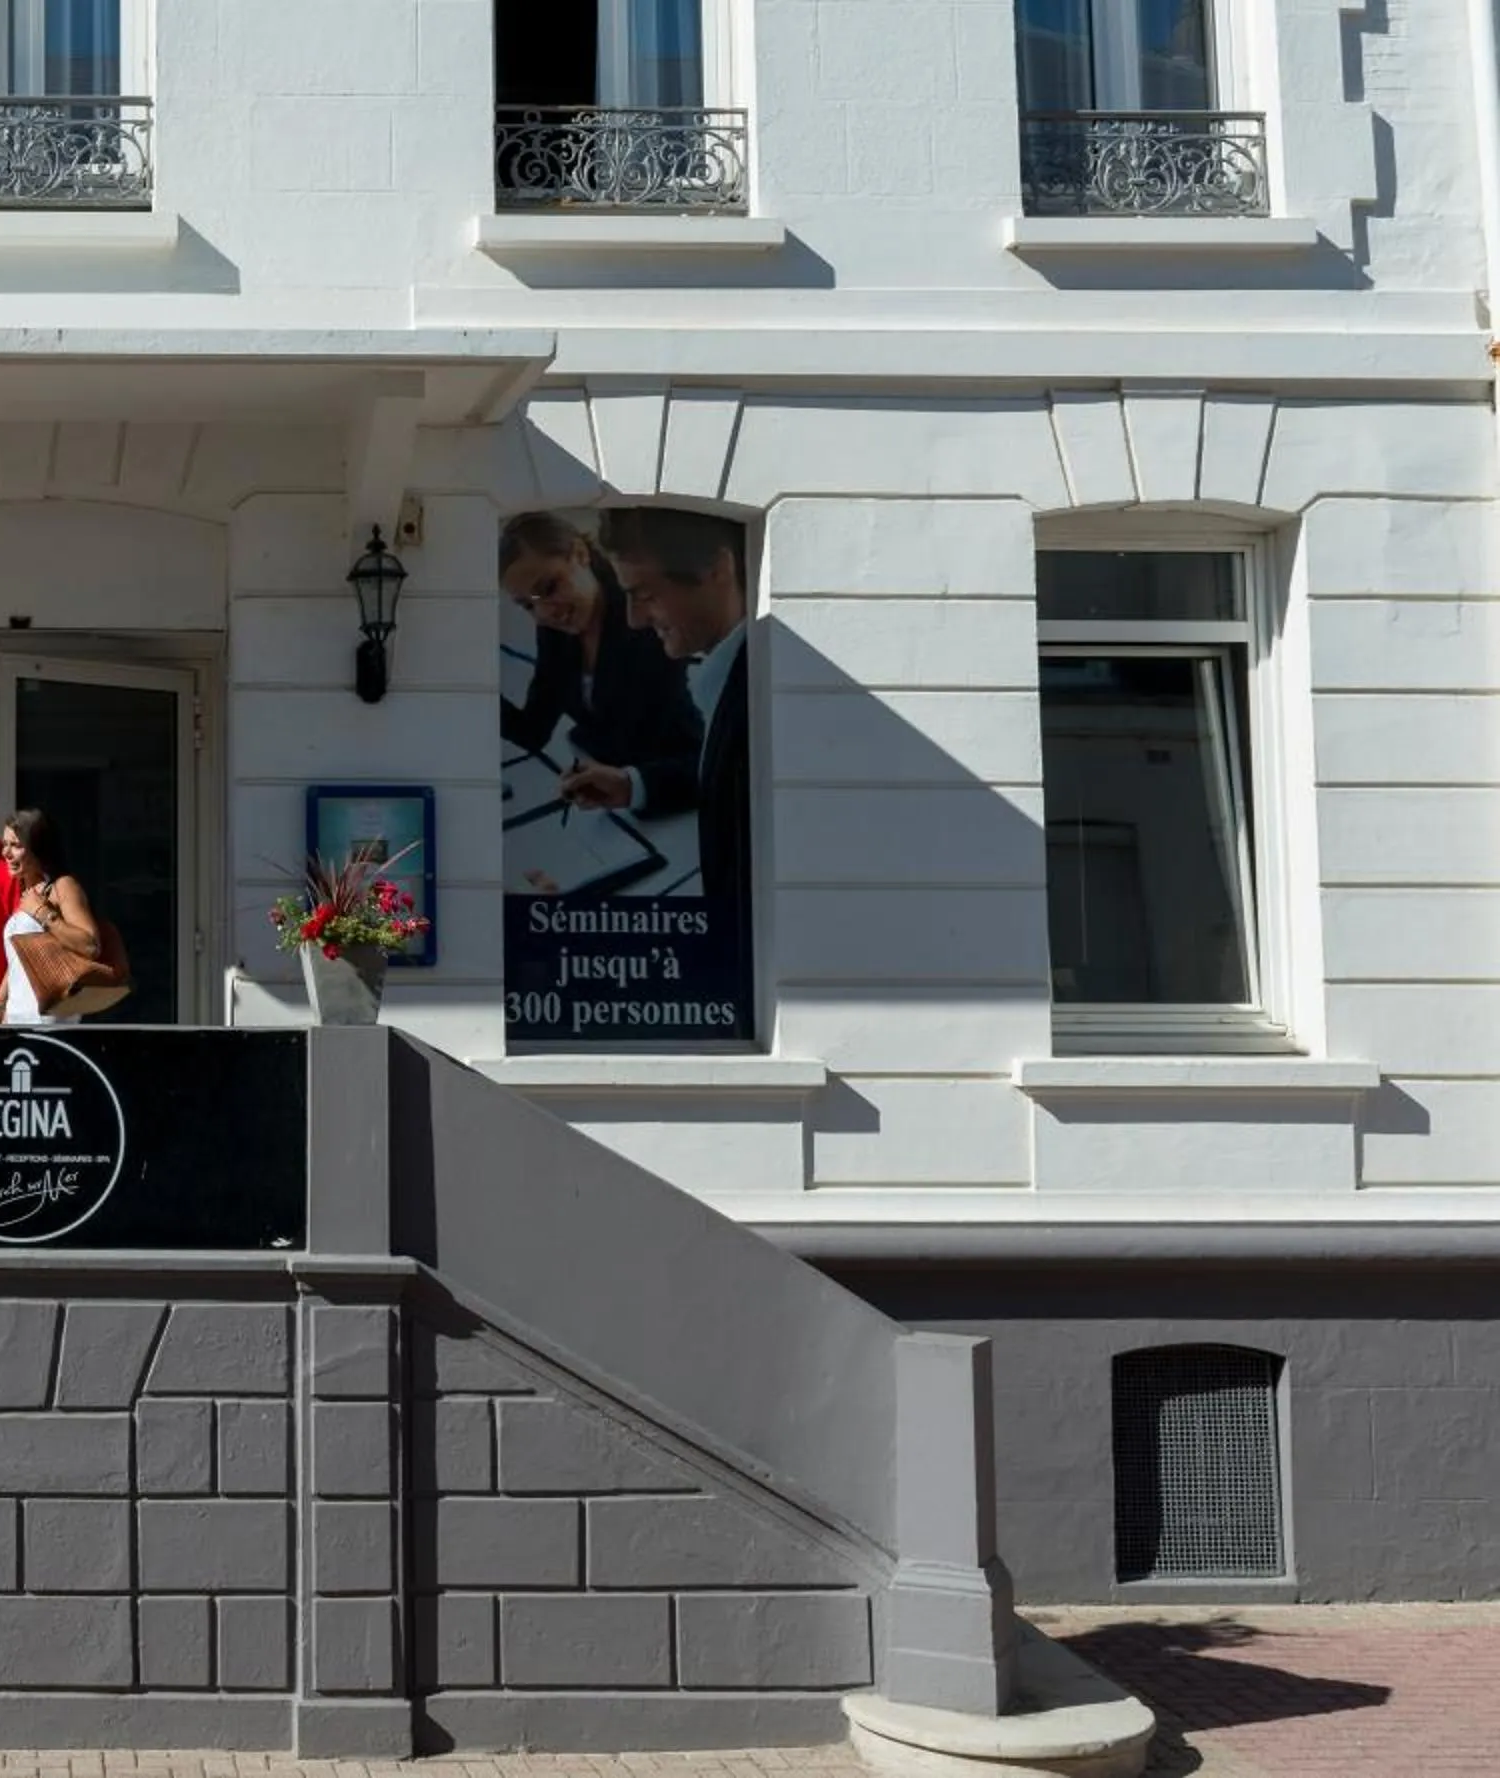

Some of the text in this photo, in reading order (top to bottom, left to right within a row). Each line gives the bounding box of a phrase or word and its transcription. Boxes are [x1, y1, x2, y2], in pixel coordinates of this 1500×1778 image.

[529, 901, 709, 934] Séminaires
[506, 991, 735, 1033] 300 personnes
